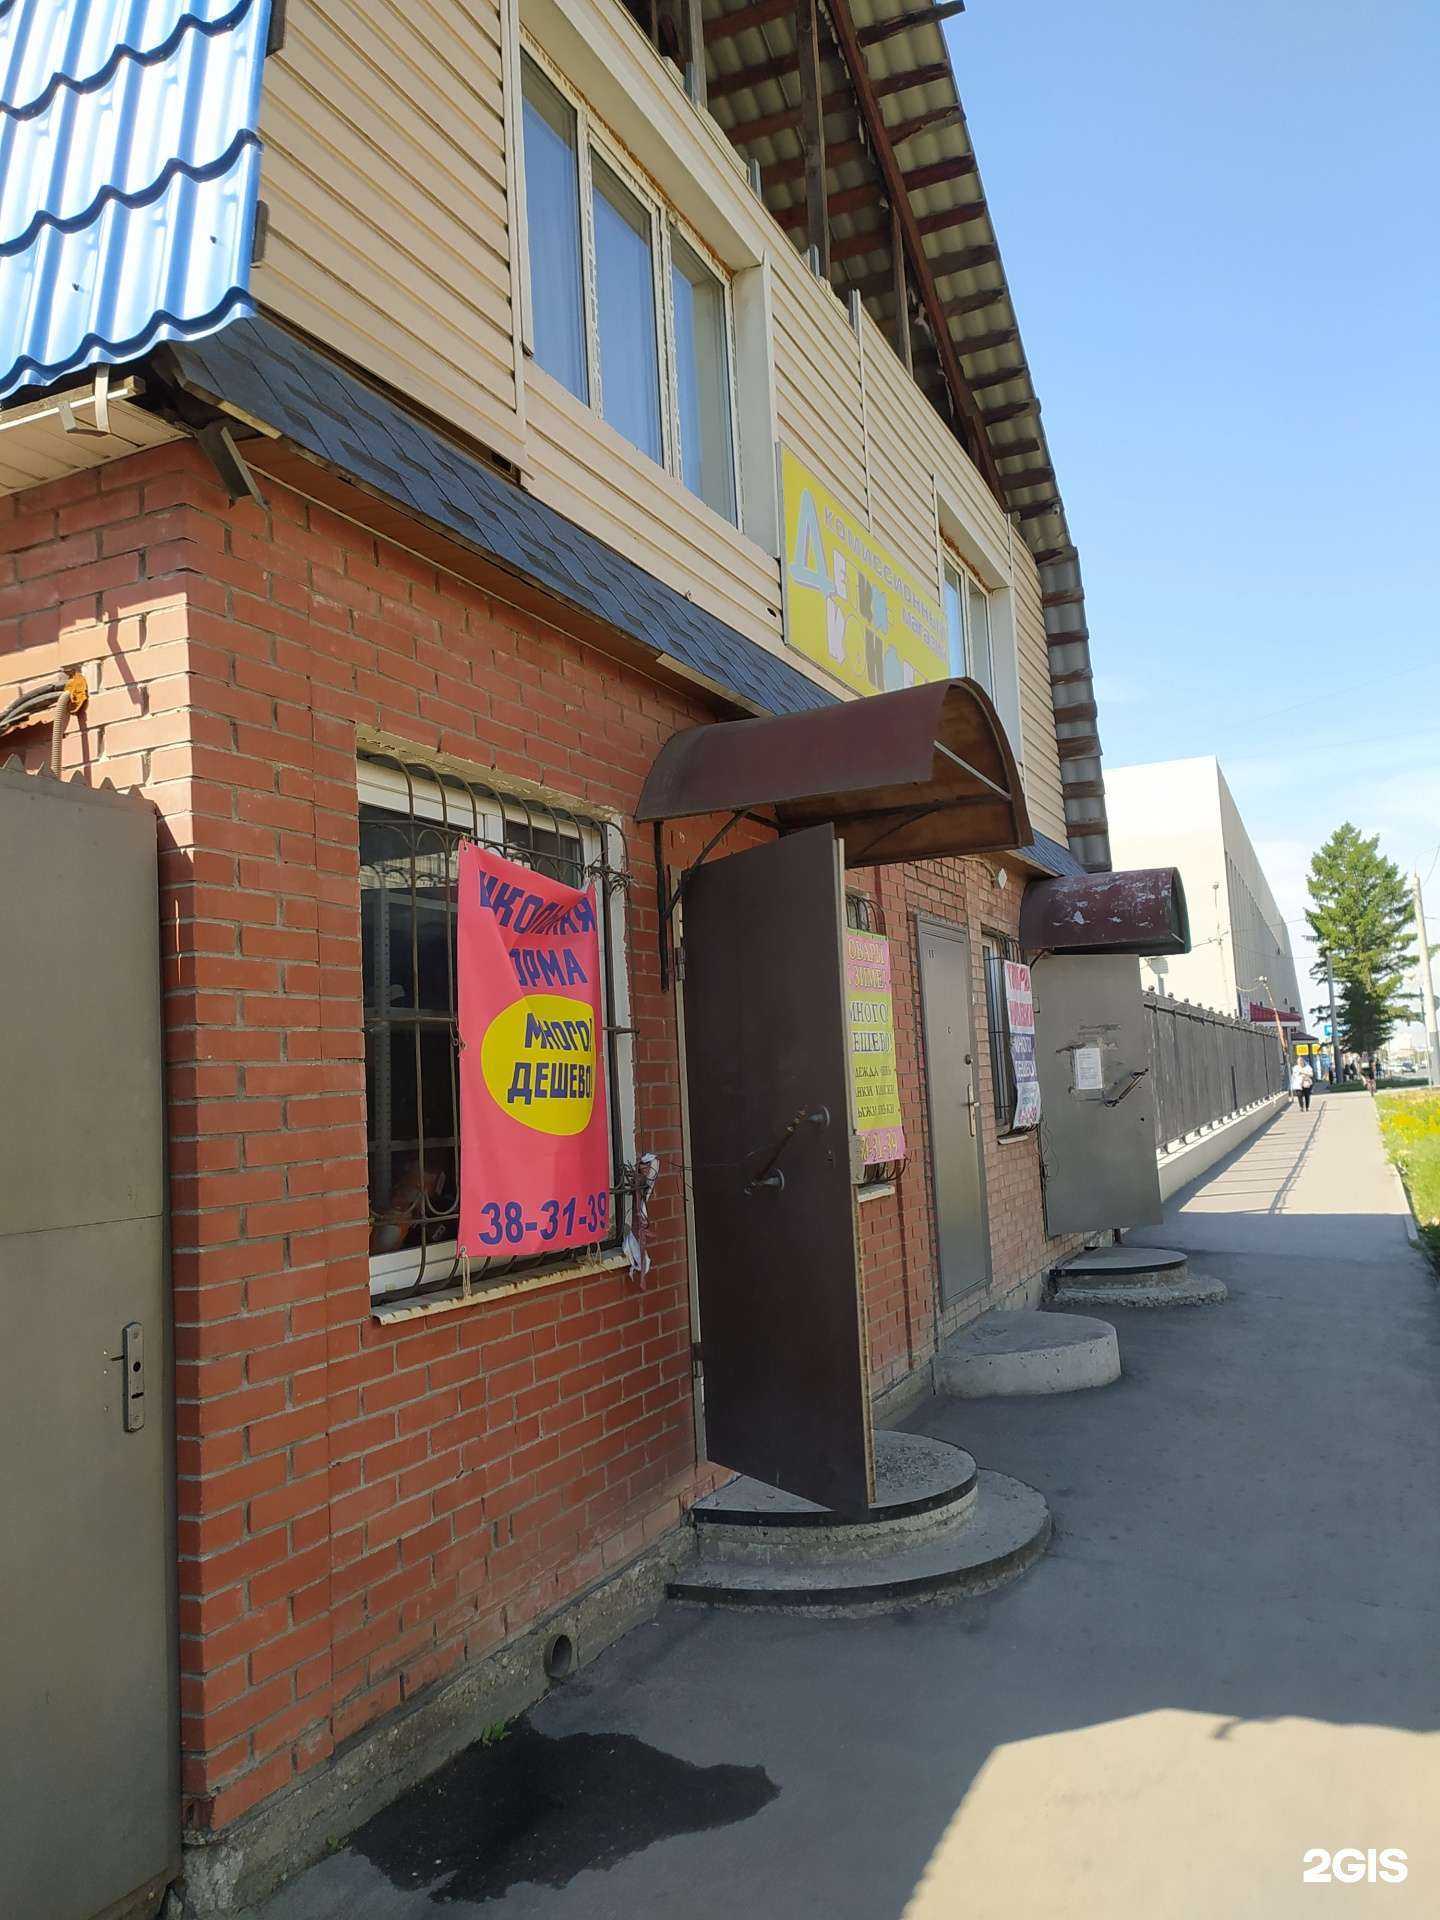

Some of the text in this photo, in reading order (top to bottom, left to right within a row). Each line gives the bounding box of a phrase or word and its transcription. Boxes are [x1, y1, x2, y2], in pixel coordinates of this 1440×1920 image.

[509, 947, 588, 988] ОРМА
[848, 940, 885, 966] ОВАРЫ
[853, 1032, 892, 1054] ЕШЕВО!
[478, 1191, 607, 1246] 38-31-39
